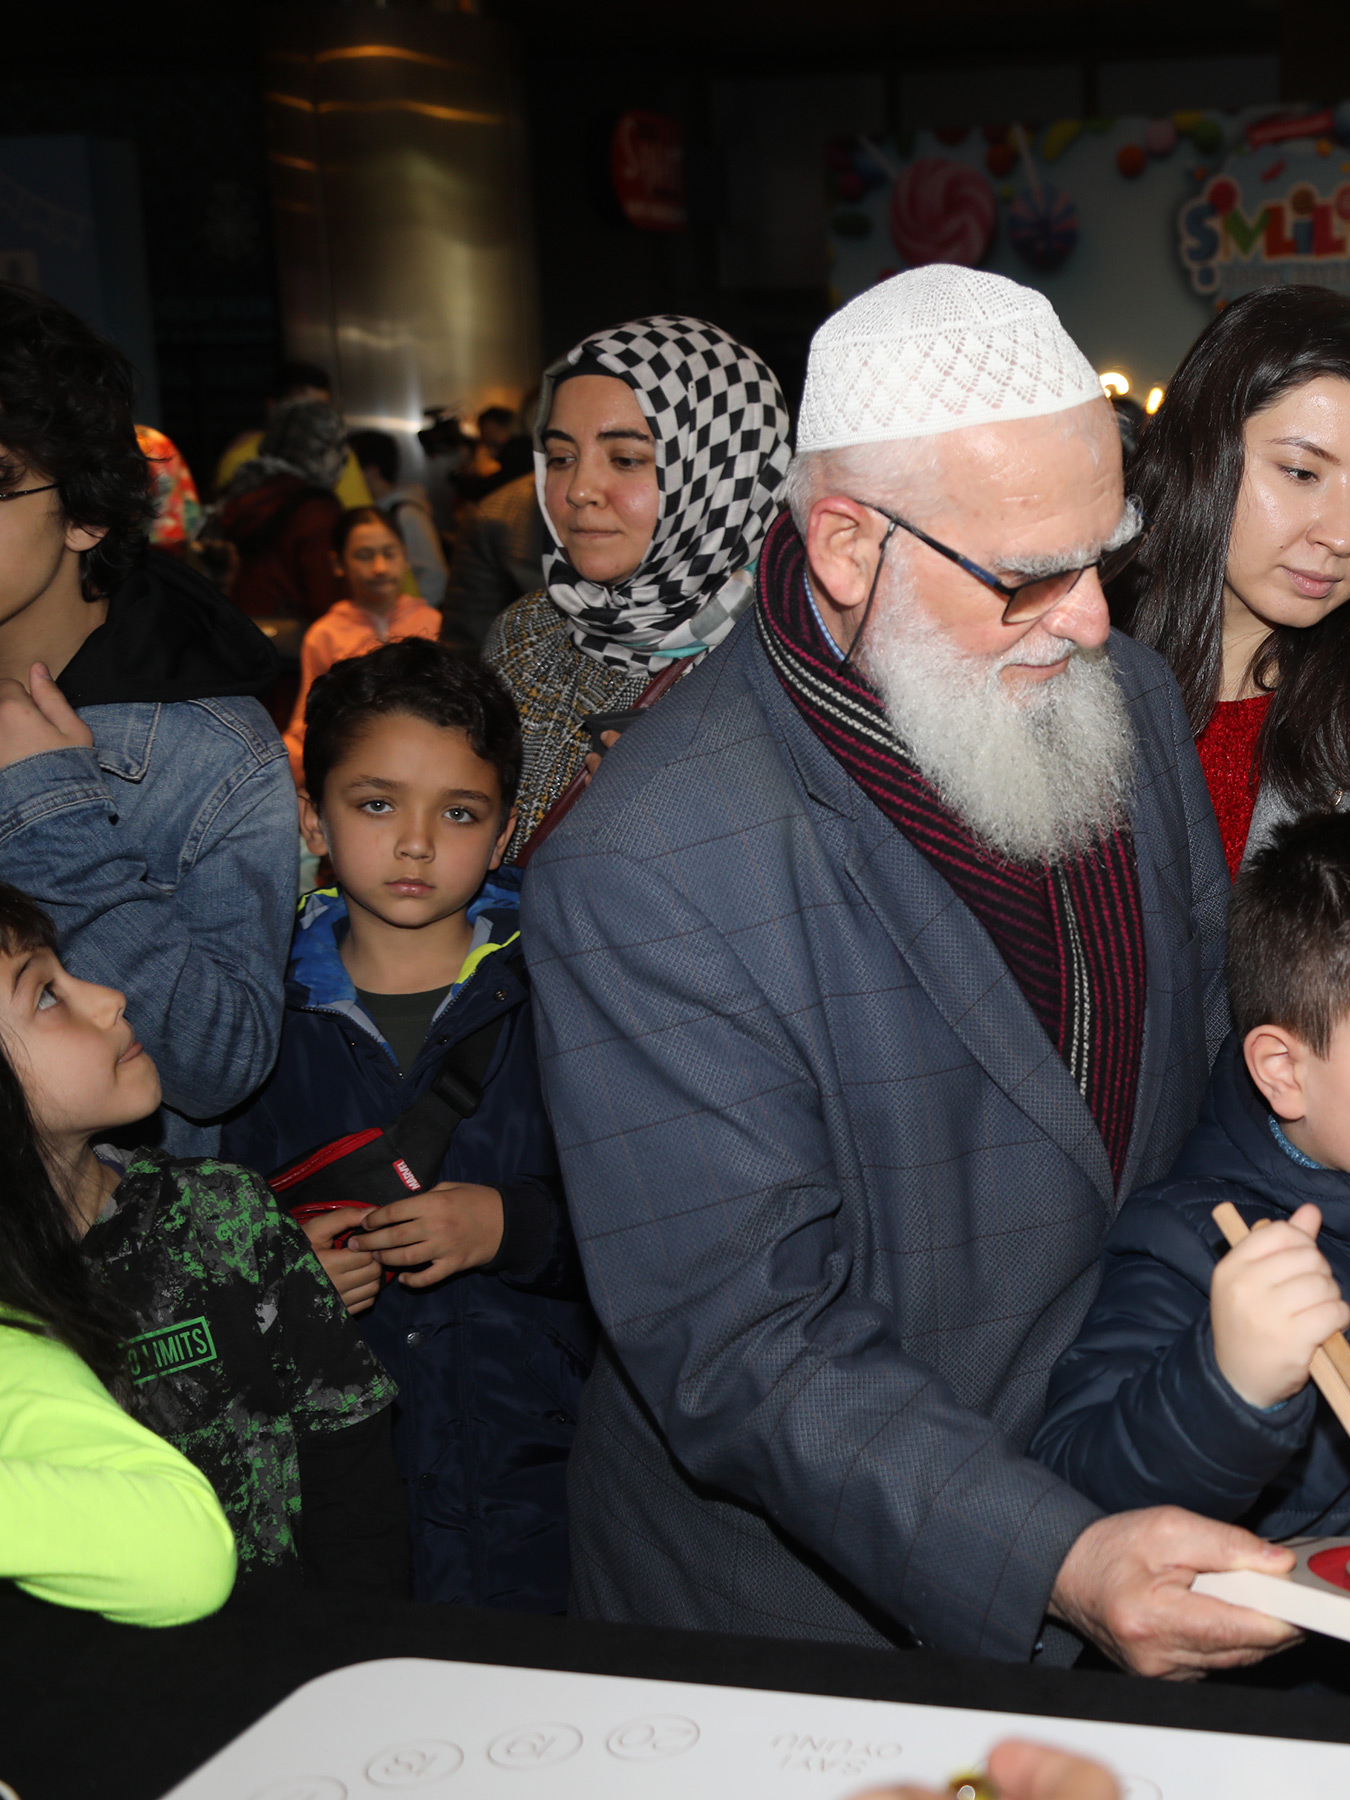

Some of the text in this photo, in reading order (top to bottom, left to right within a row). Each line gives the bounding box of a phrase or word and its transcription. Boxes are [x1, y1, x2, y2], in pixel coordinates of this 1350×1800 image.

[396, 1160, 421, 1190] MARVEL
[142, 1327, 208, 1371] LIMITS
[769, 1731, 904, 1760] OYUNU
